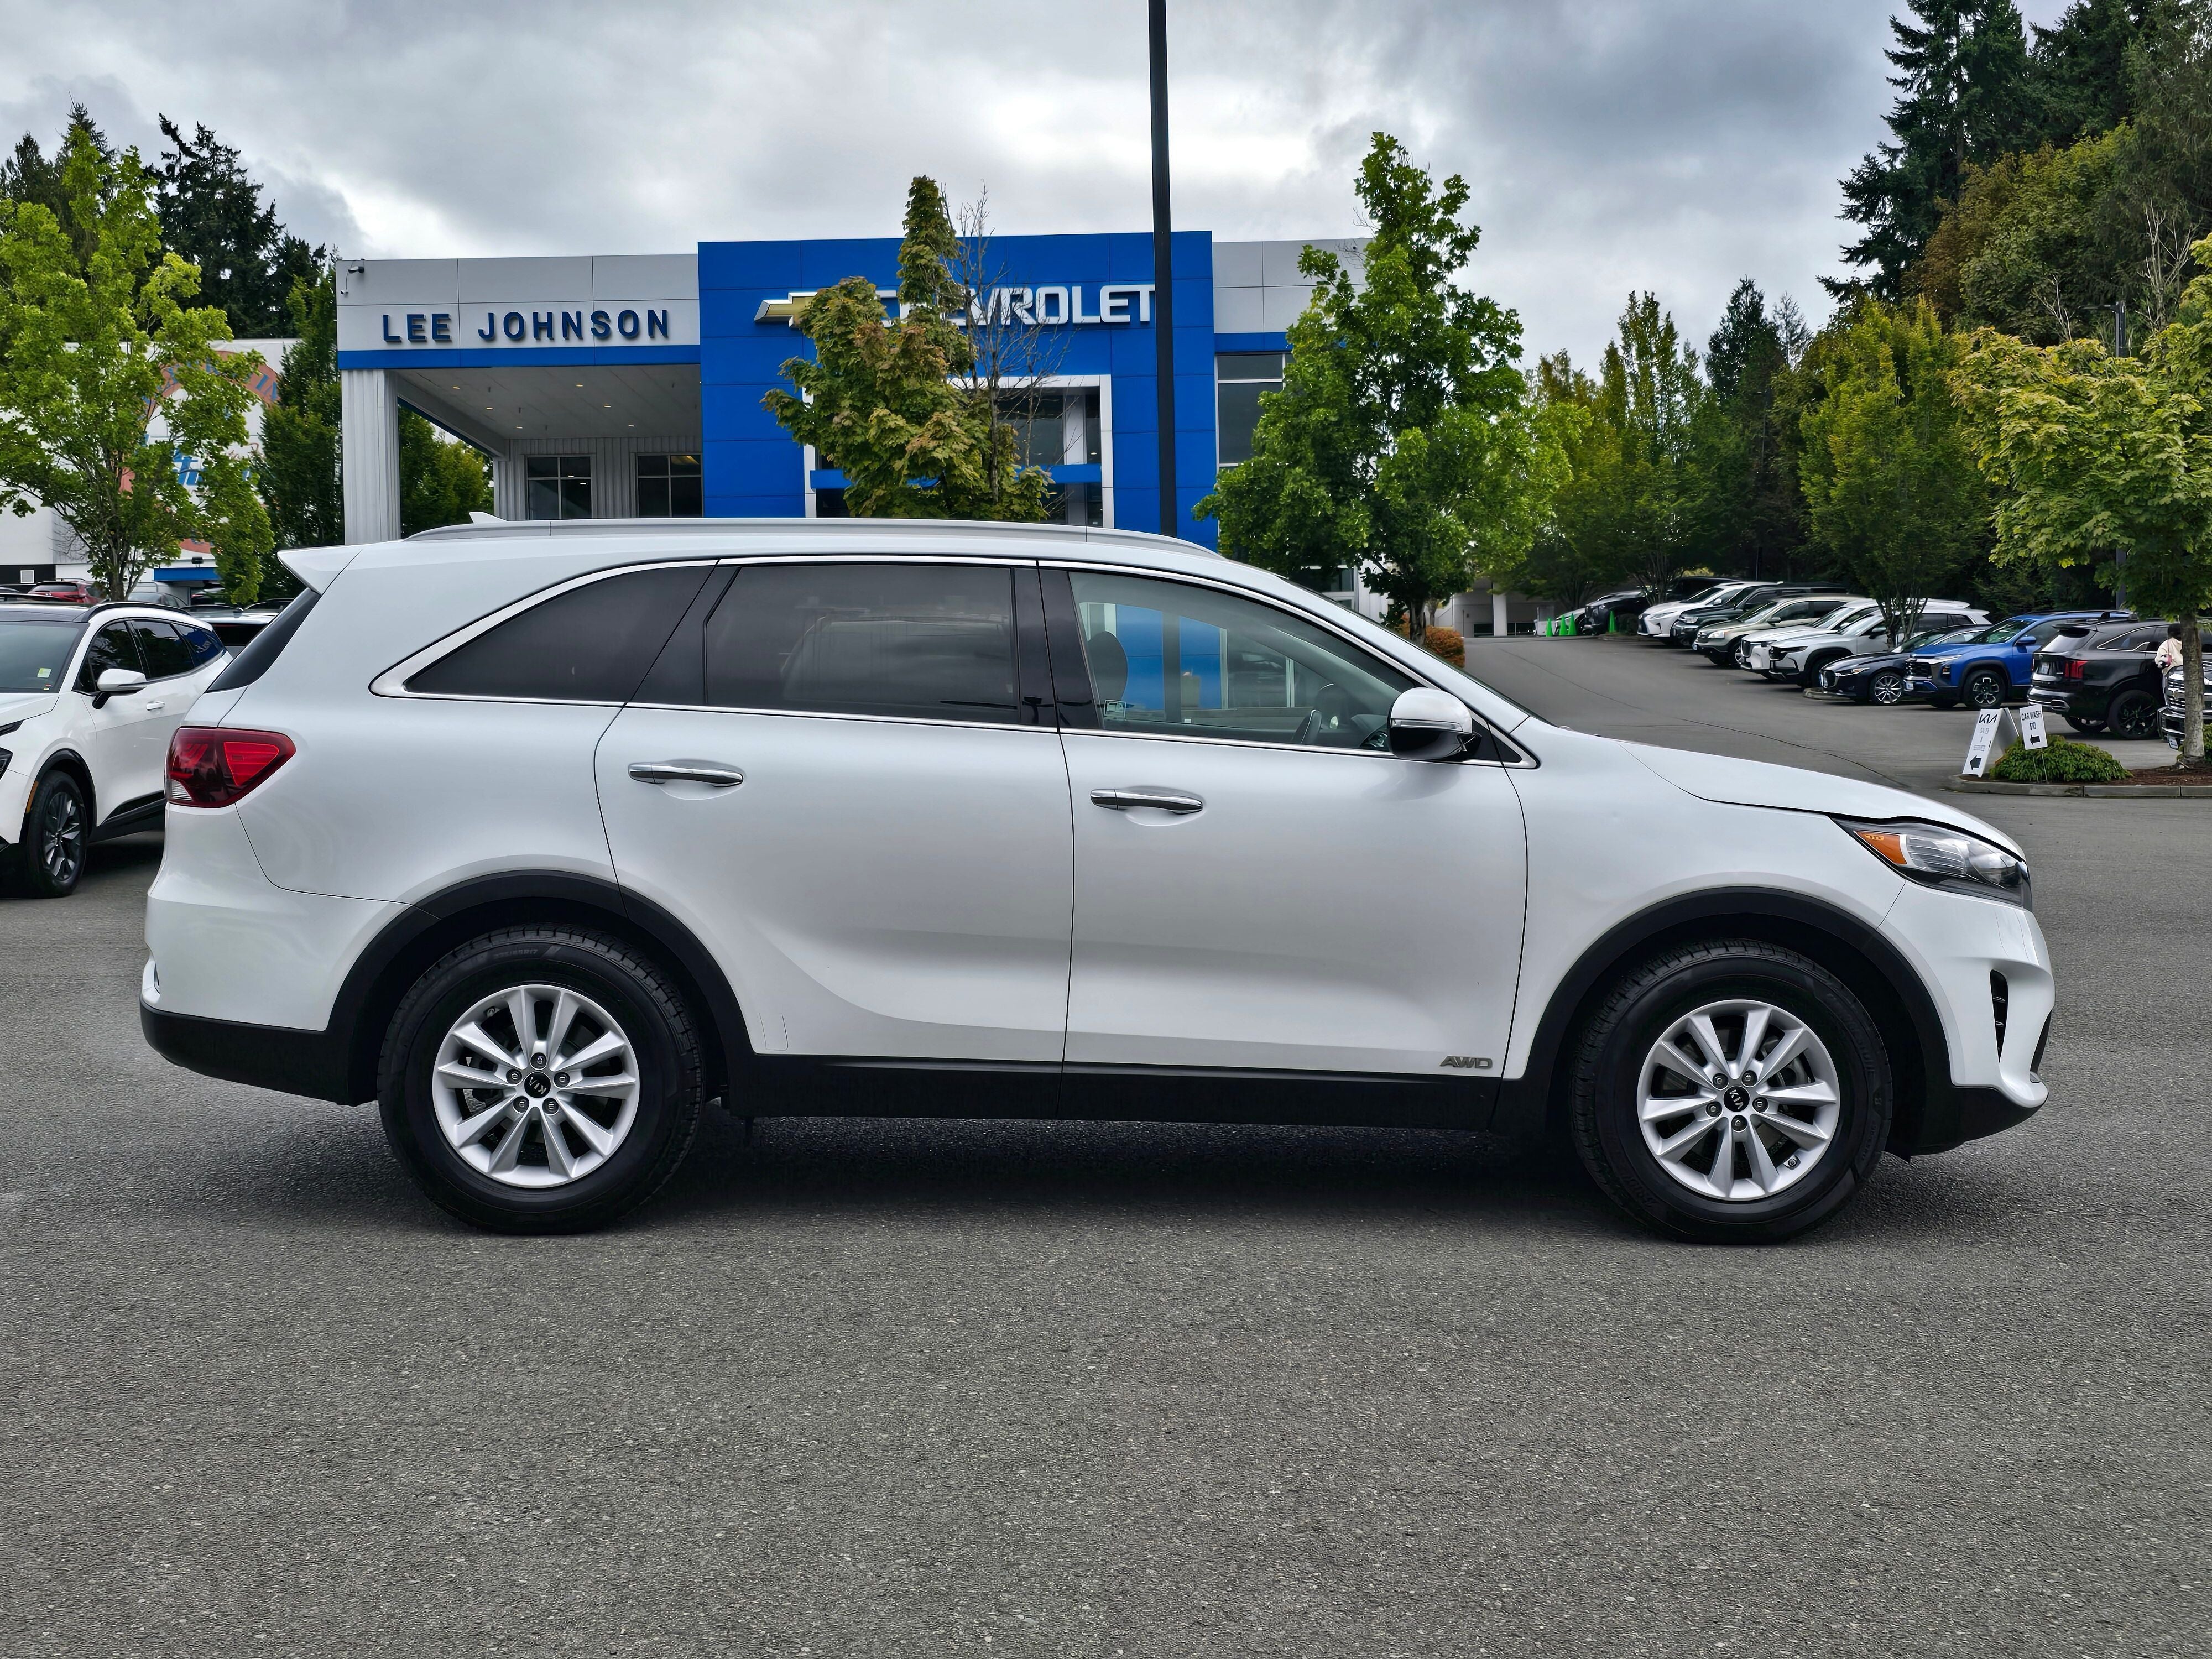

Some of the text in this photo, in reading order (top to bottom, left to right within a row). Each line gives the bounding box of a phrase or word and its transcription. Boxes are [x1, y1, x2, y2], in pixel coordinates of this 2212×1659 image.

[874, 284, 1155, 328] VROLET
[383, 310, 668, 342] LEE JOHNSON
[1979, 714, 1997, 724] KIA
[2021, 712, 2030, 721] CAR
[1439, 1056, 1493, 1069] AWD
[529, 1076, 547, 1094] KIA
[1729, 1089, 1744, 1110] KIA
